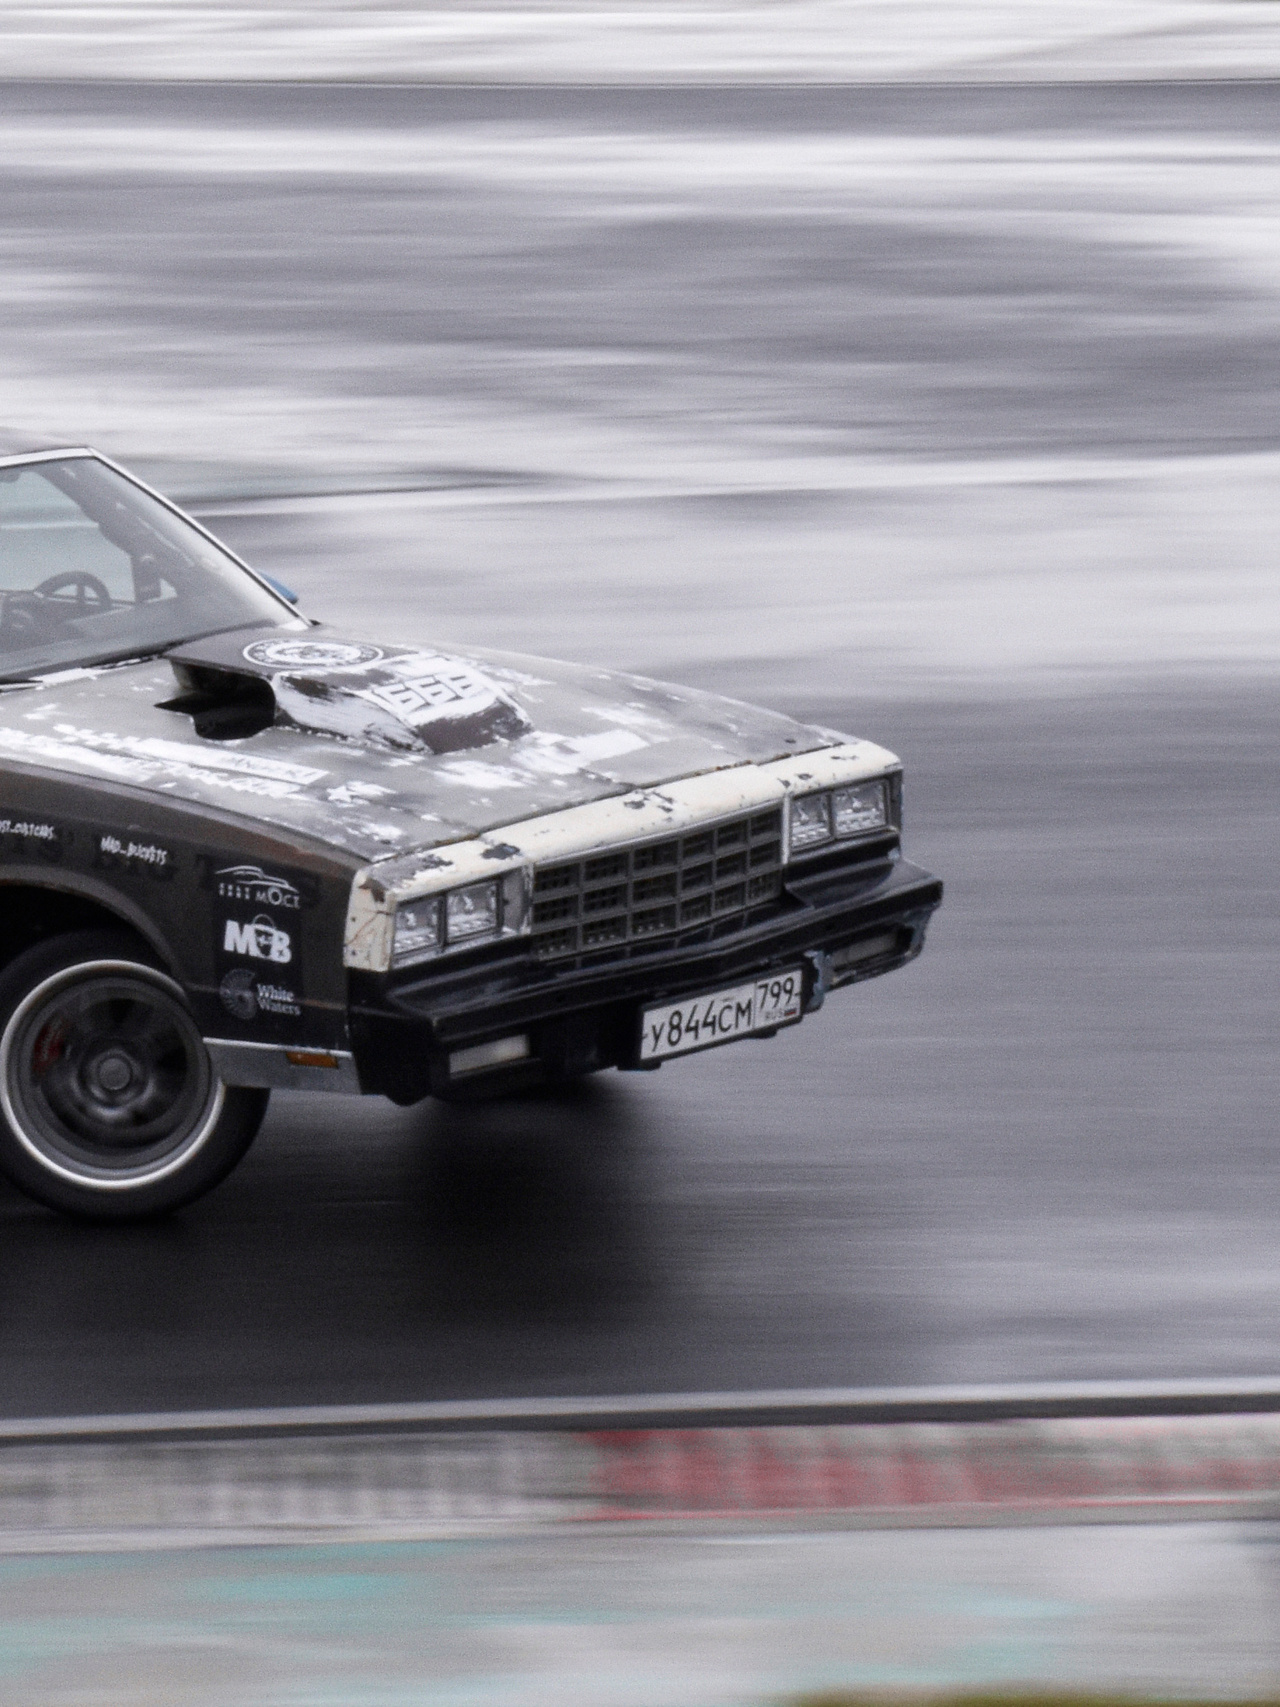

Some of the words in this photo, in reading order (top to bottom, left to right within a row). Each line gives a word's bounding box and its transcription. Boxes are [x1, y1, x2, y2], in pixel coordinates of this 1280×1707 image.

[257, 983, 294, 1002] White
[651, 998, 752, 1053] У844СМ
[757, 976, 795, 1011] 799
